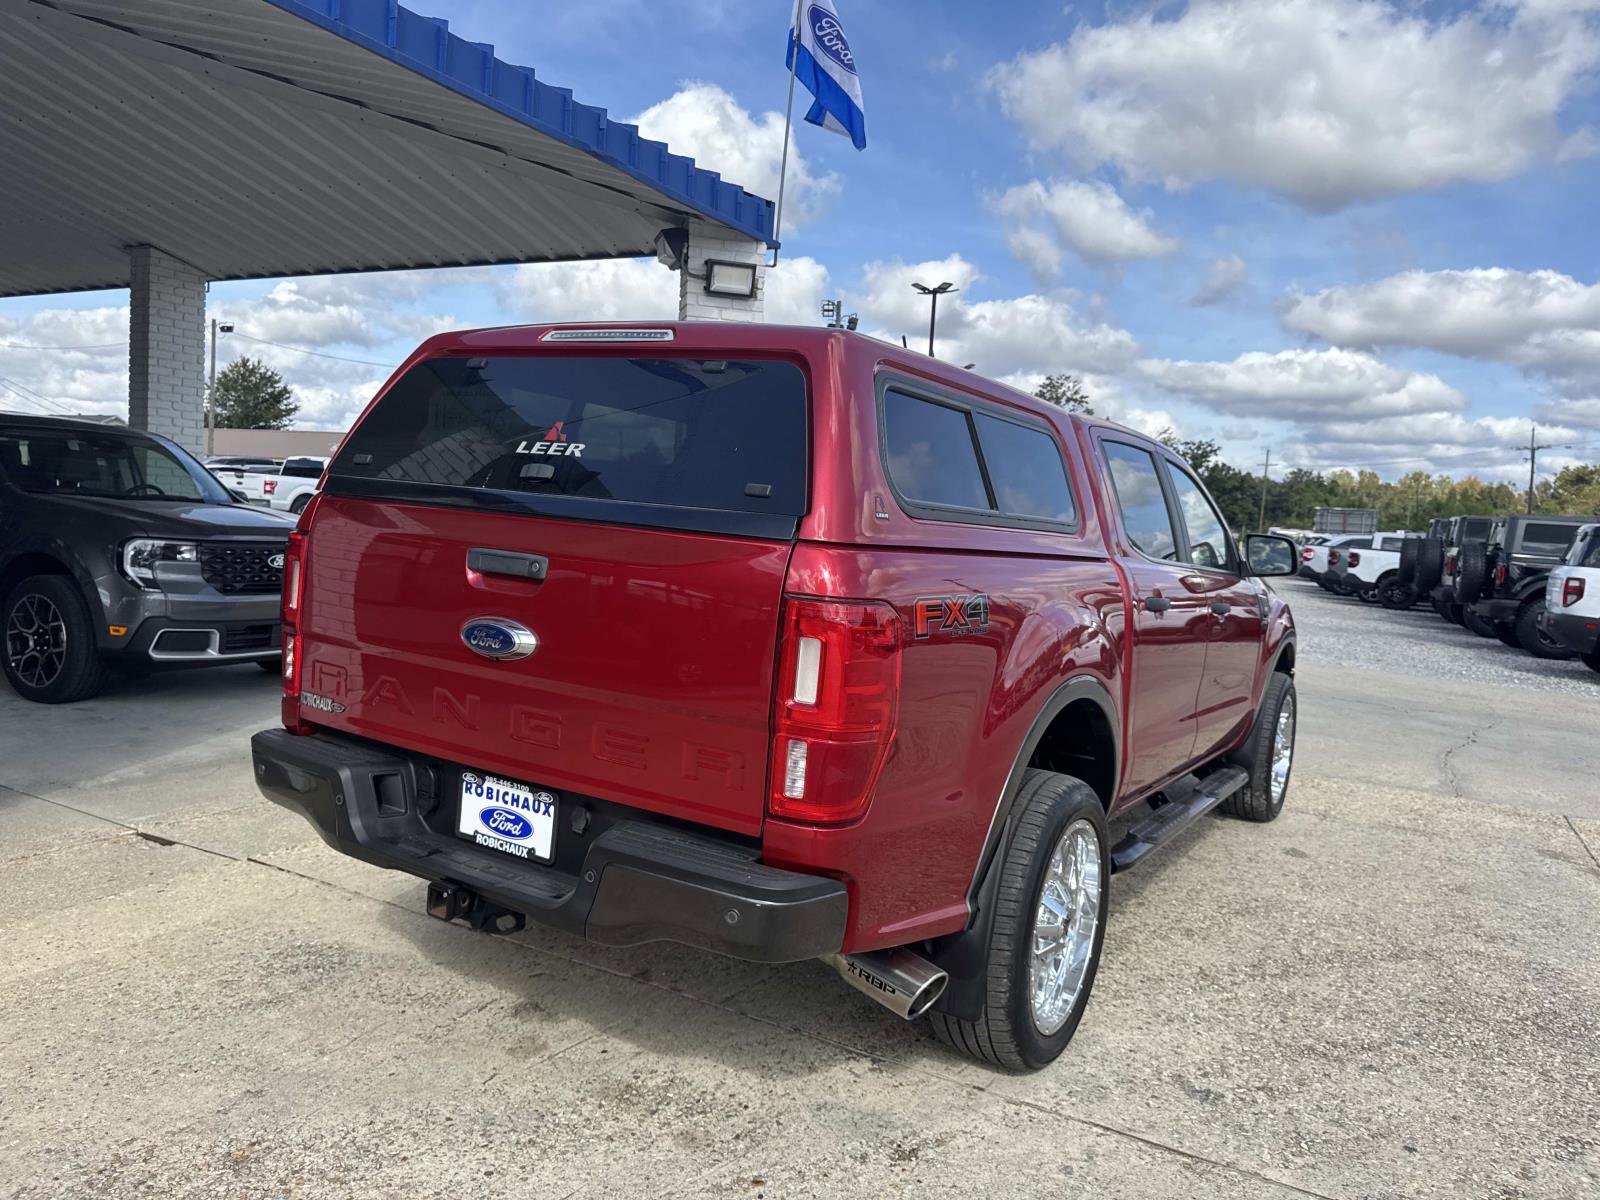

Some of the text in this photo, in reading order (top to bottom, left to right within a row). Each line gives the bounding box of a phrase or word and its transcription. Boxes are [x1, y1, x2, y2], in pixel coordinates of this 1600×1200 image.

[815, 17, 853, 64] Ford
[515, 440, 586, 458] LEER
[914, 593, 990, 640] FX4
[470, 626, 504, 650] Ford
[311, 658, 746, 792] RANGER
[464, 782, 552, 818] ROBICHAUX
[489, 810, 523, 836] Ford
[475, 834, 528, 858] ROBICHAUX
[858, 968, 896, 995] RBP
